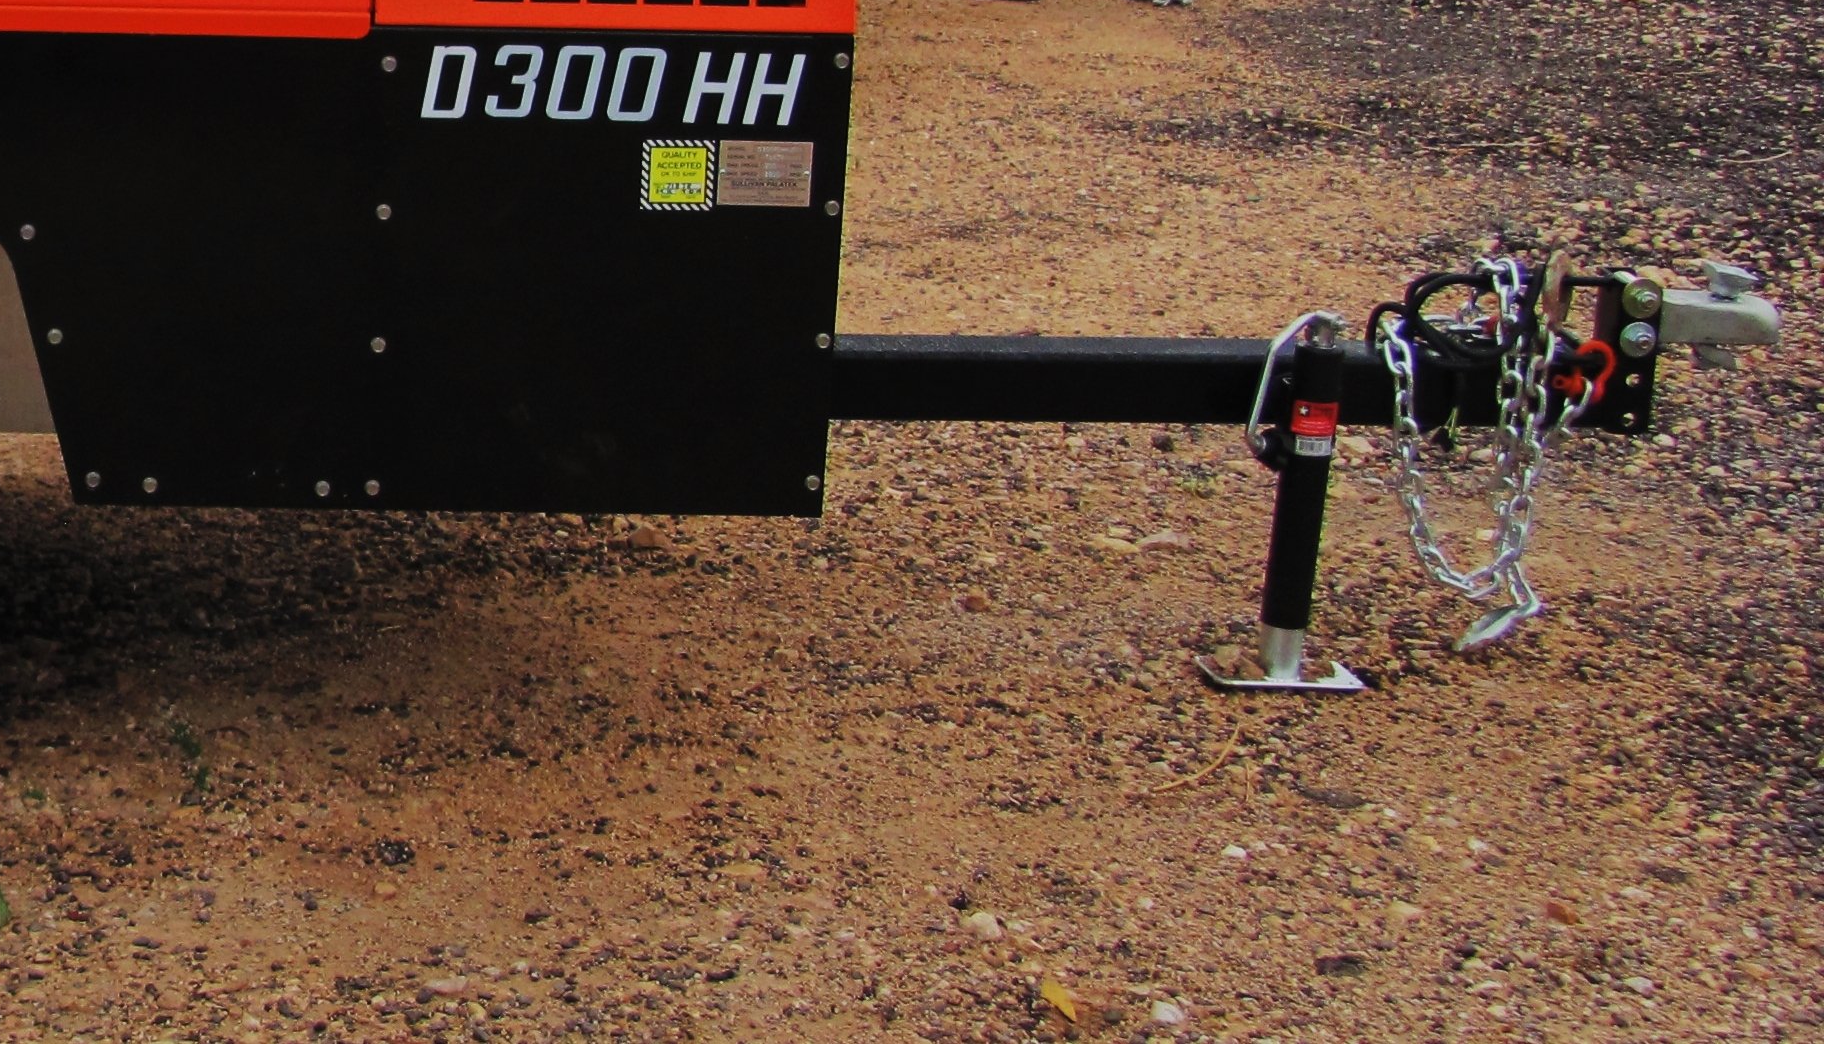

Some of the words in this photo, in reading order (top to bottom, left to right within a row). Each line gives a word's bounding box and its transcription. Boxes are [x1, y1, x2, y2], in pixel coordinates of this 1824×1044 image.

[682, 51, 807, 126] HH
[661, 151, 698, 159] QUALITY
[657, 162, 702, 170] ACCEPTED
